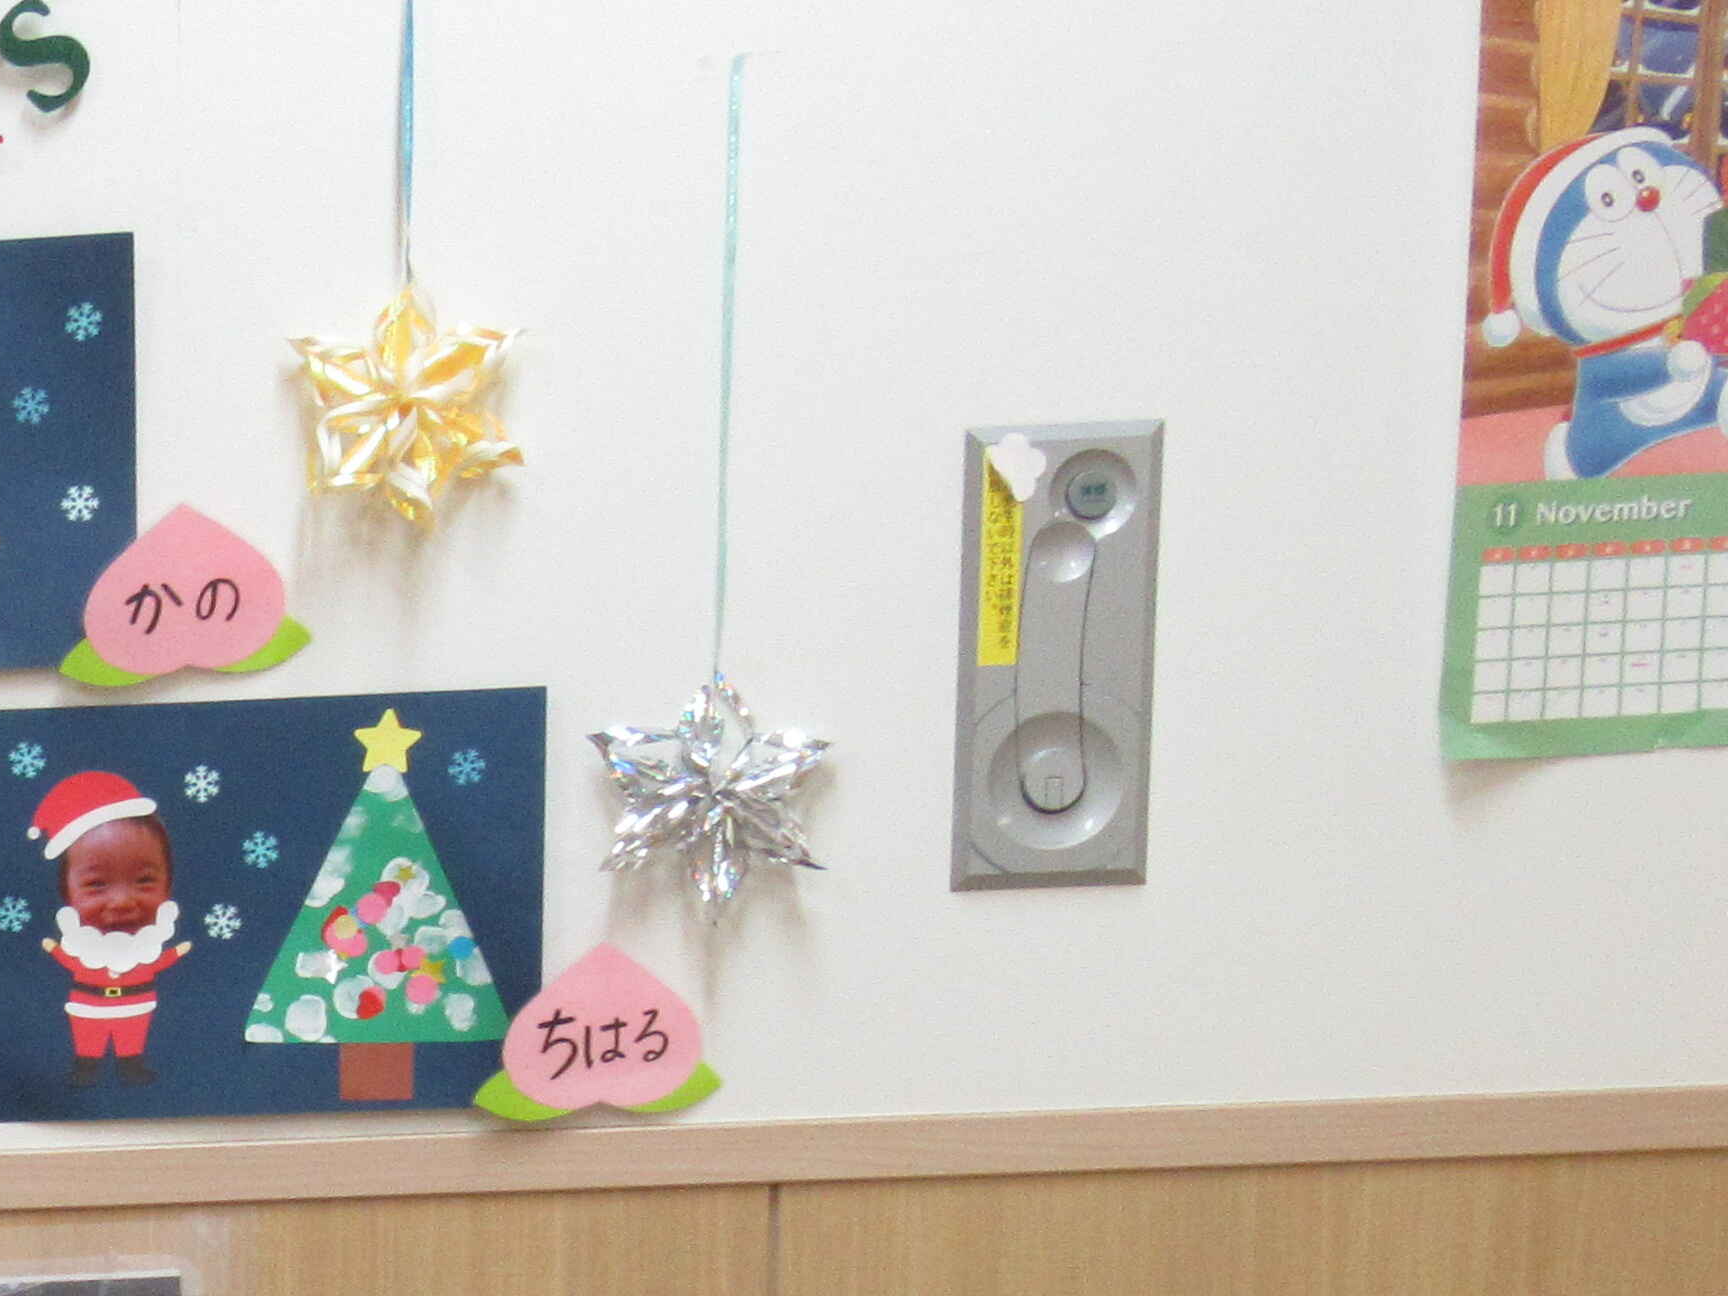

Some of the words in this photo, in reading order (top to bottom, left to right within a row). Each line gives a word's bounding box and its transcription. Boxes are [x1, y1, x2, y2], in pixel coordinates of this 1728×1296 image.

[1494, 502, 1518, 527] 11
[1535, 497, 1693, 525] November
[125, 578, 241, 635] かの
[537, 1009, 669, 1080] ちはる
